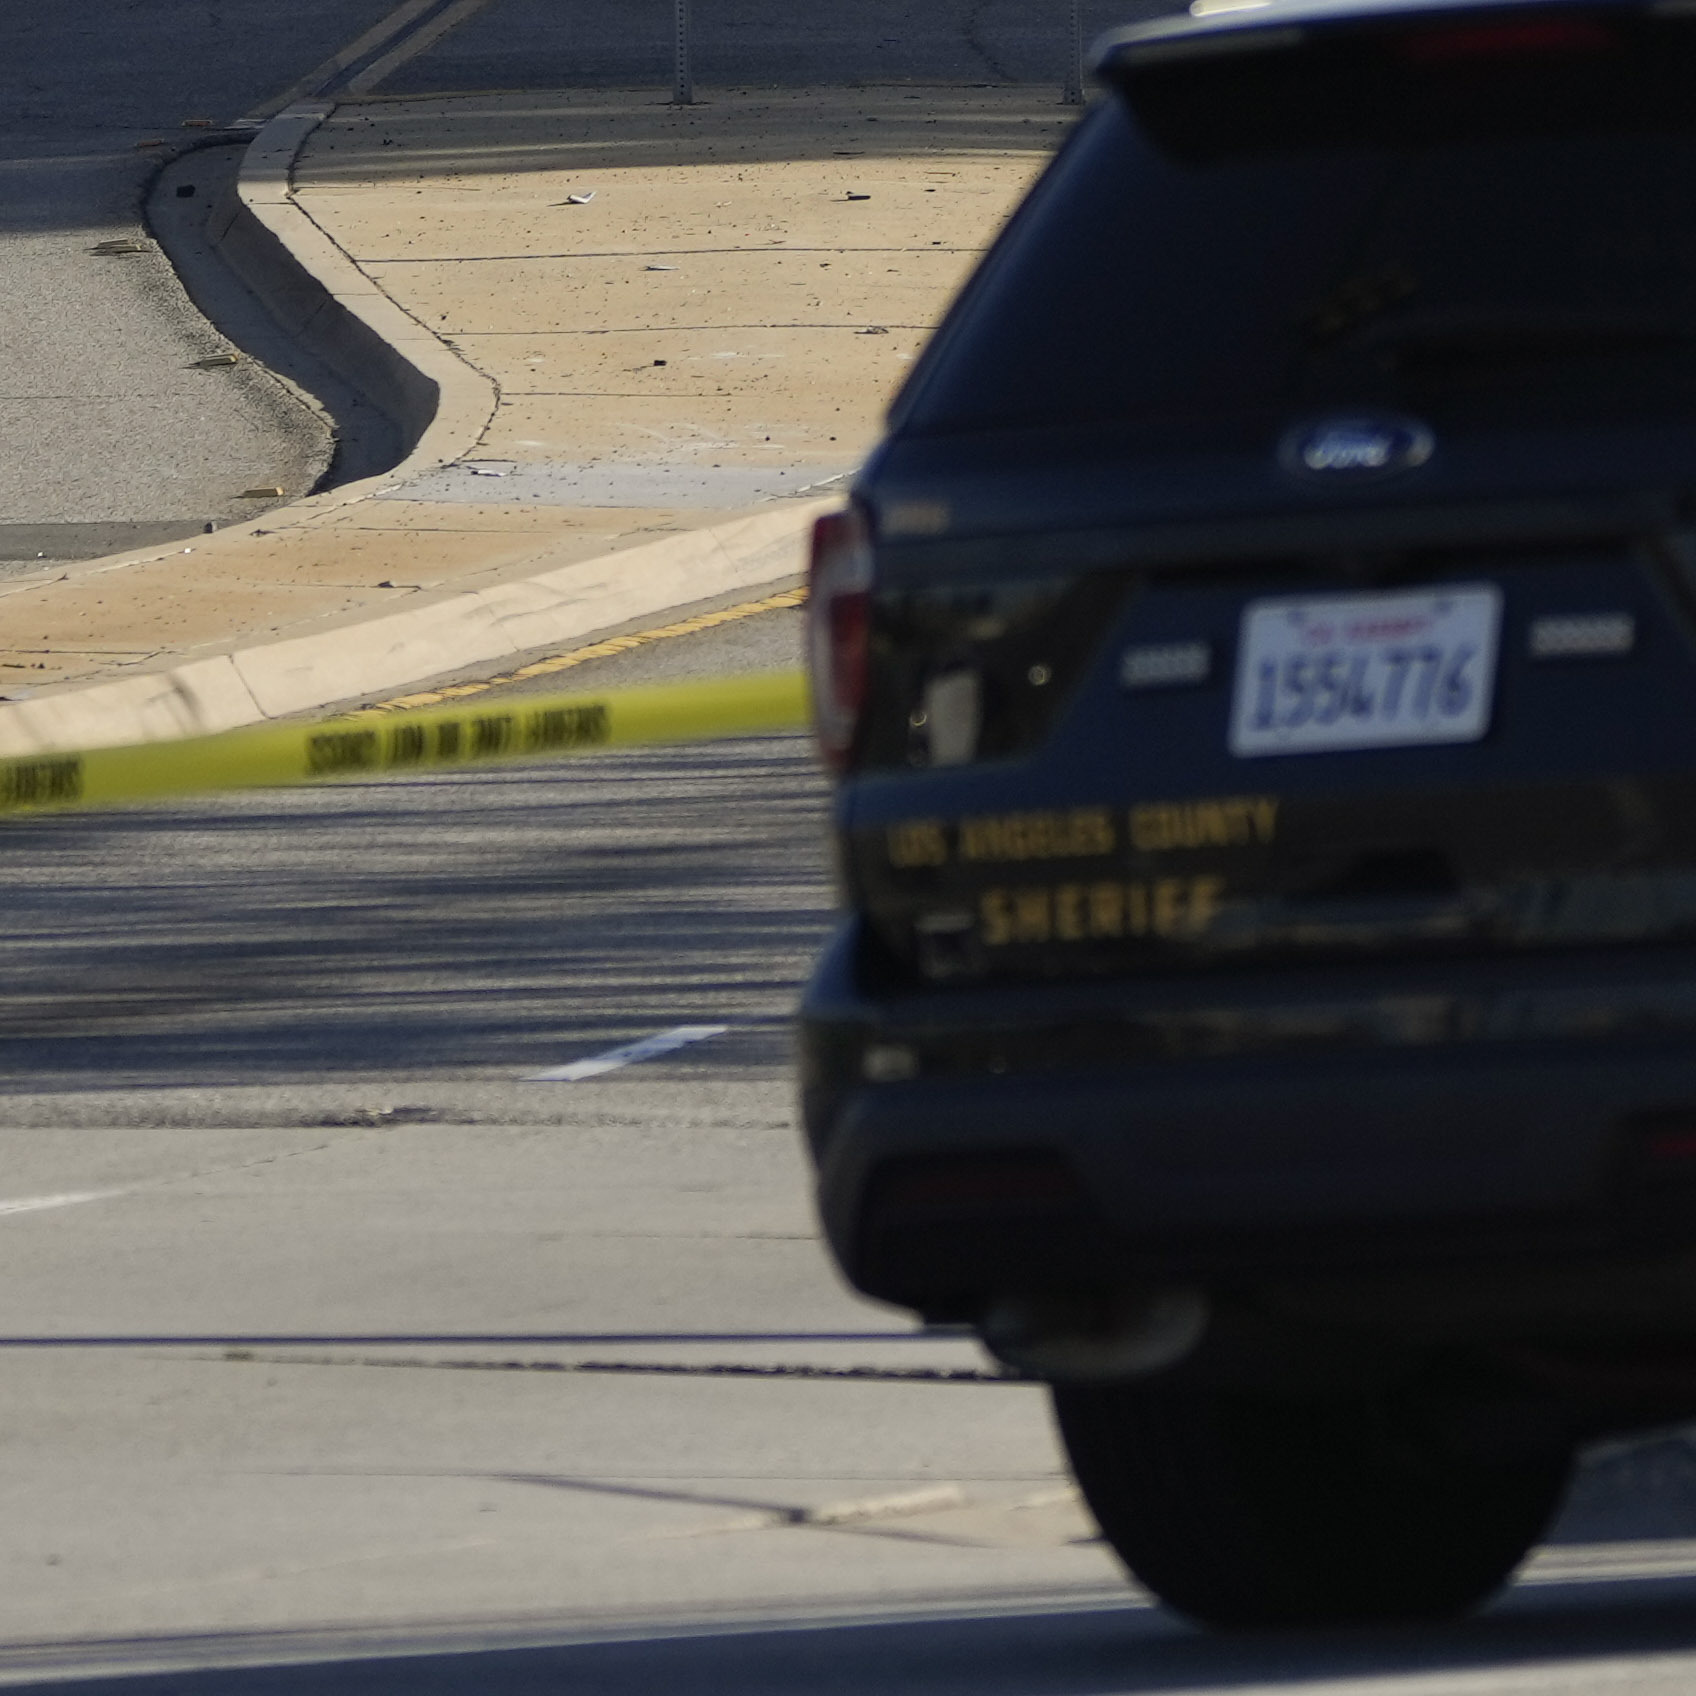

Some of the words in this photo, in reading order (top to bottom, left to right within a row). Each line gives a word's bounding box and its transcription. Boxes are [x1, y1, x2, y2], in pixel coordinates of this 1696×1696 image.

[958, 807, 1117, 865] ANGELES
[1129, 796, 1279, 851] COUNTY
[980, 874, 1226, 946] SHERIFF
